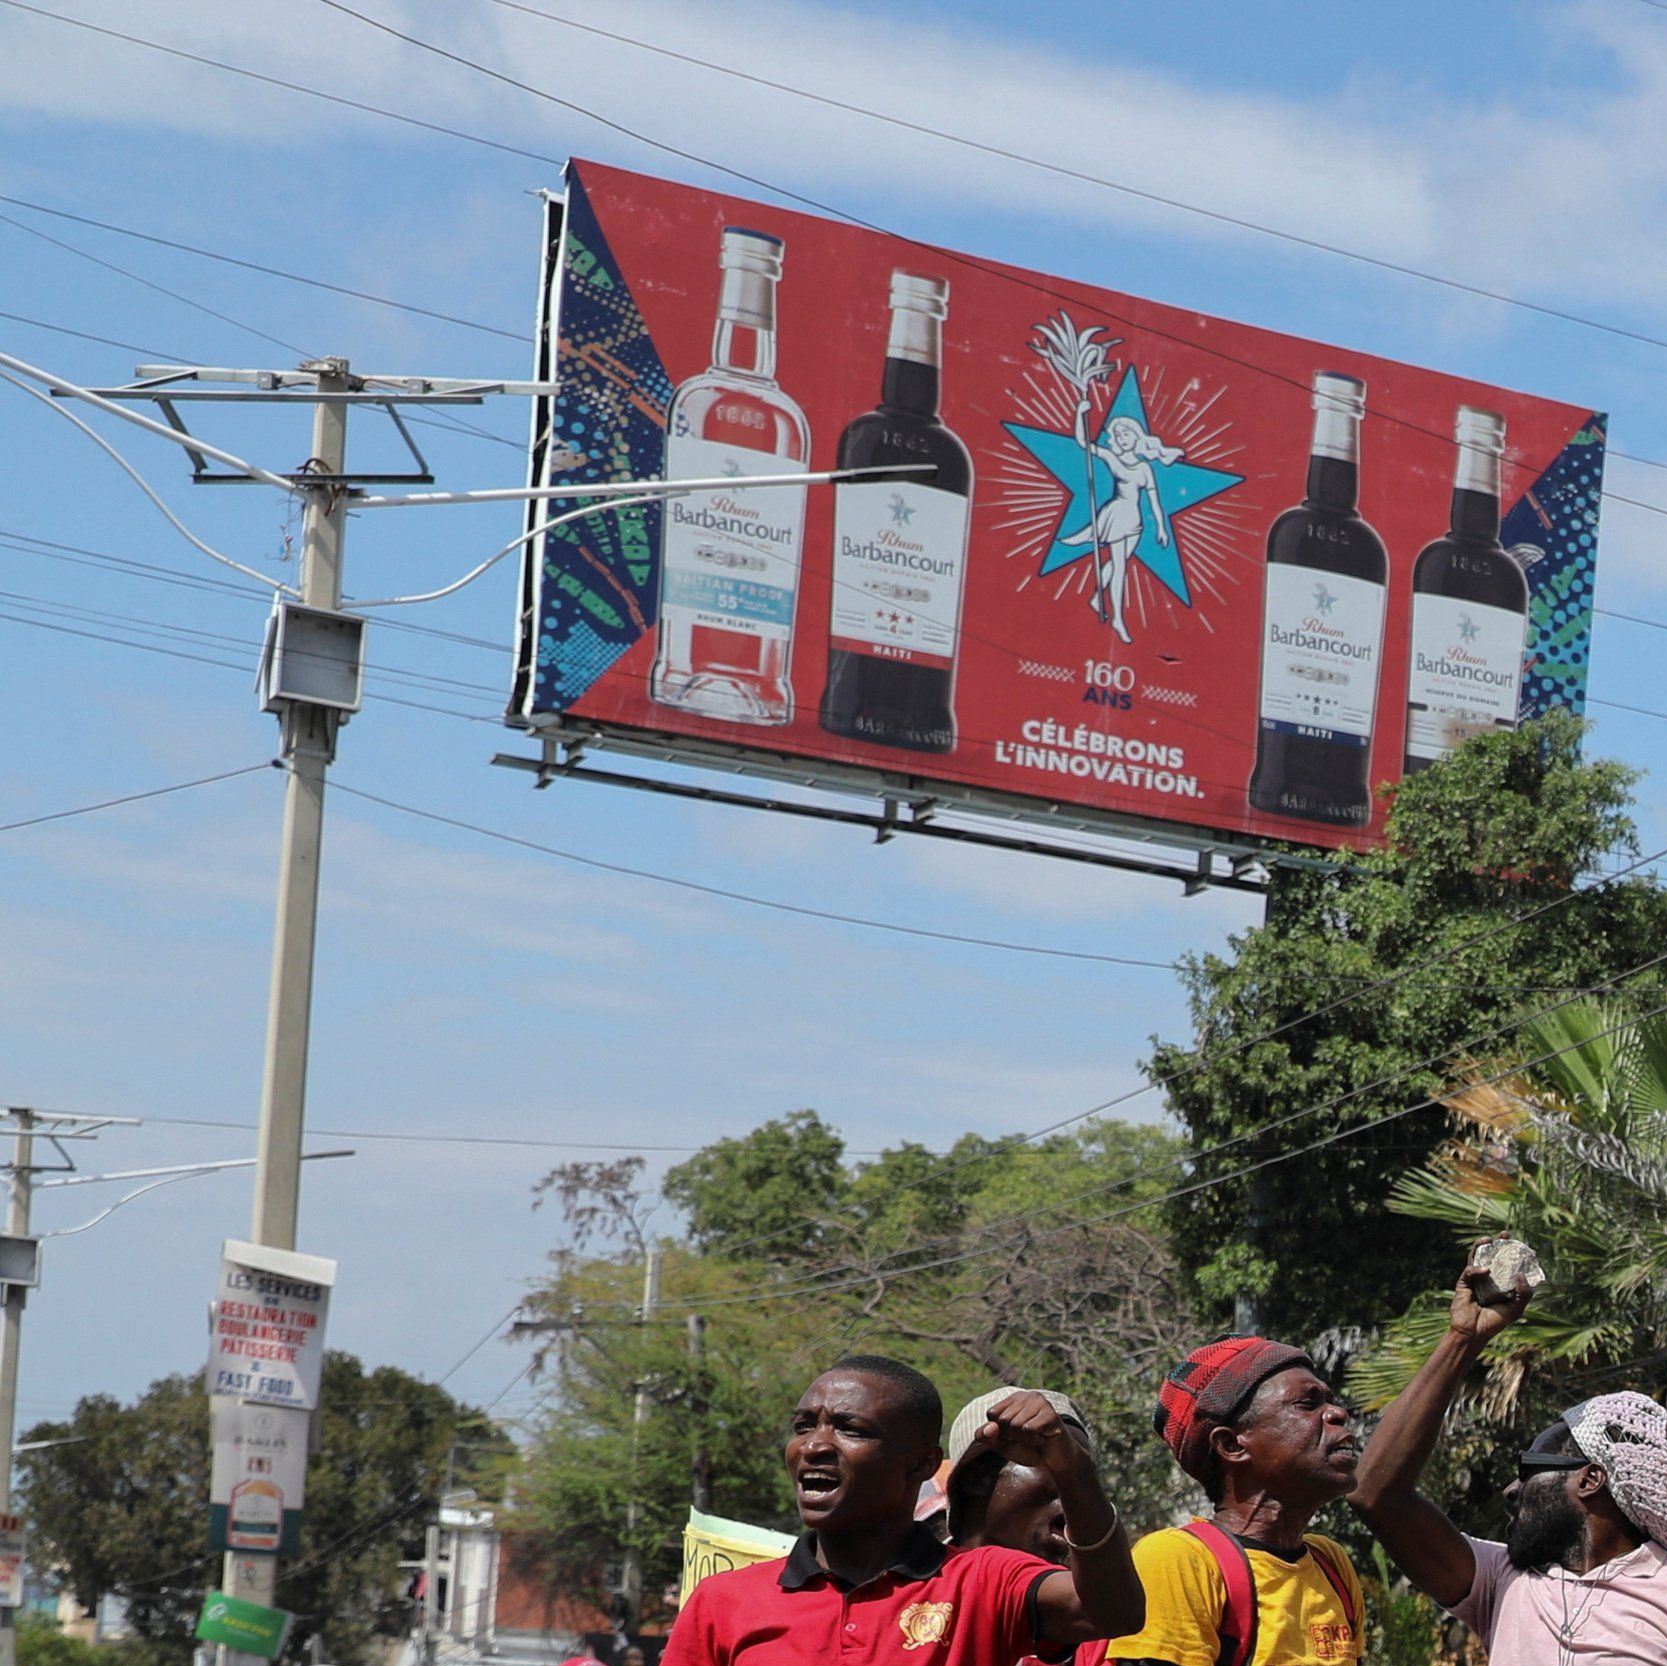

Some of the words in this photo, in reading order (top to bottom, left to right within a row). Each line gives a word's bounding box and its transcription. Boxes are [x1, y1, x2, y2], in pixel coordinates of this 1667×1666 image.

[716, 405, 765, 430] 1862
[711, 496, 760, 519] Rhum
[673, 502, 793, 545] Barbancourt
[877, 529, 923, 552] Rhum
[842, 535, 955, 577] Barbancourt
[1302, 617, 1345, 638] Rhum
[872, 644, 913, 661] HAITI
[1269, 623, 1373, 662] Barbancourt
[1447, 646, 1488, 667] Rhum
[1083, 659, 1136, 692] 160
[1416, 652, 1514, 690] Barbancourt
[1083, 686, 1133, 711] ANS
[1021, 717, 1185, 770] CÉLÉBRONS
[1297, 726, 1333, 741] HAITI
[227, 1271, 253, 1291] LES
[257, 1277, 321, 1302] SERVICES
[219, 1299, 319, 1330] RESTAURATION
[218, 1318, 307, 1347] BOULANGERIE
[217, 1370, 253, 1391] FAST
[258, 1376, 295, 1397] FOOD
[1331, 1625, 1351, 1641] KP
